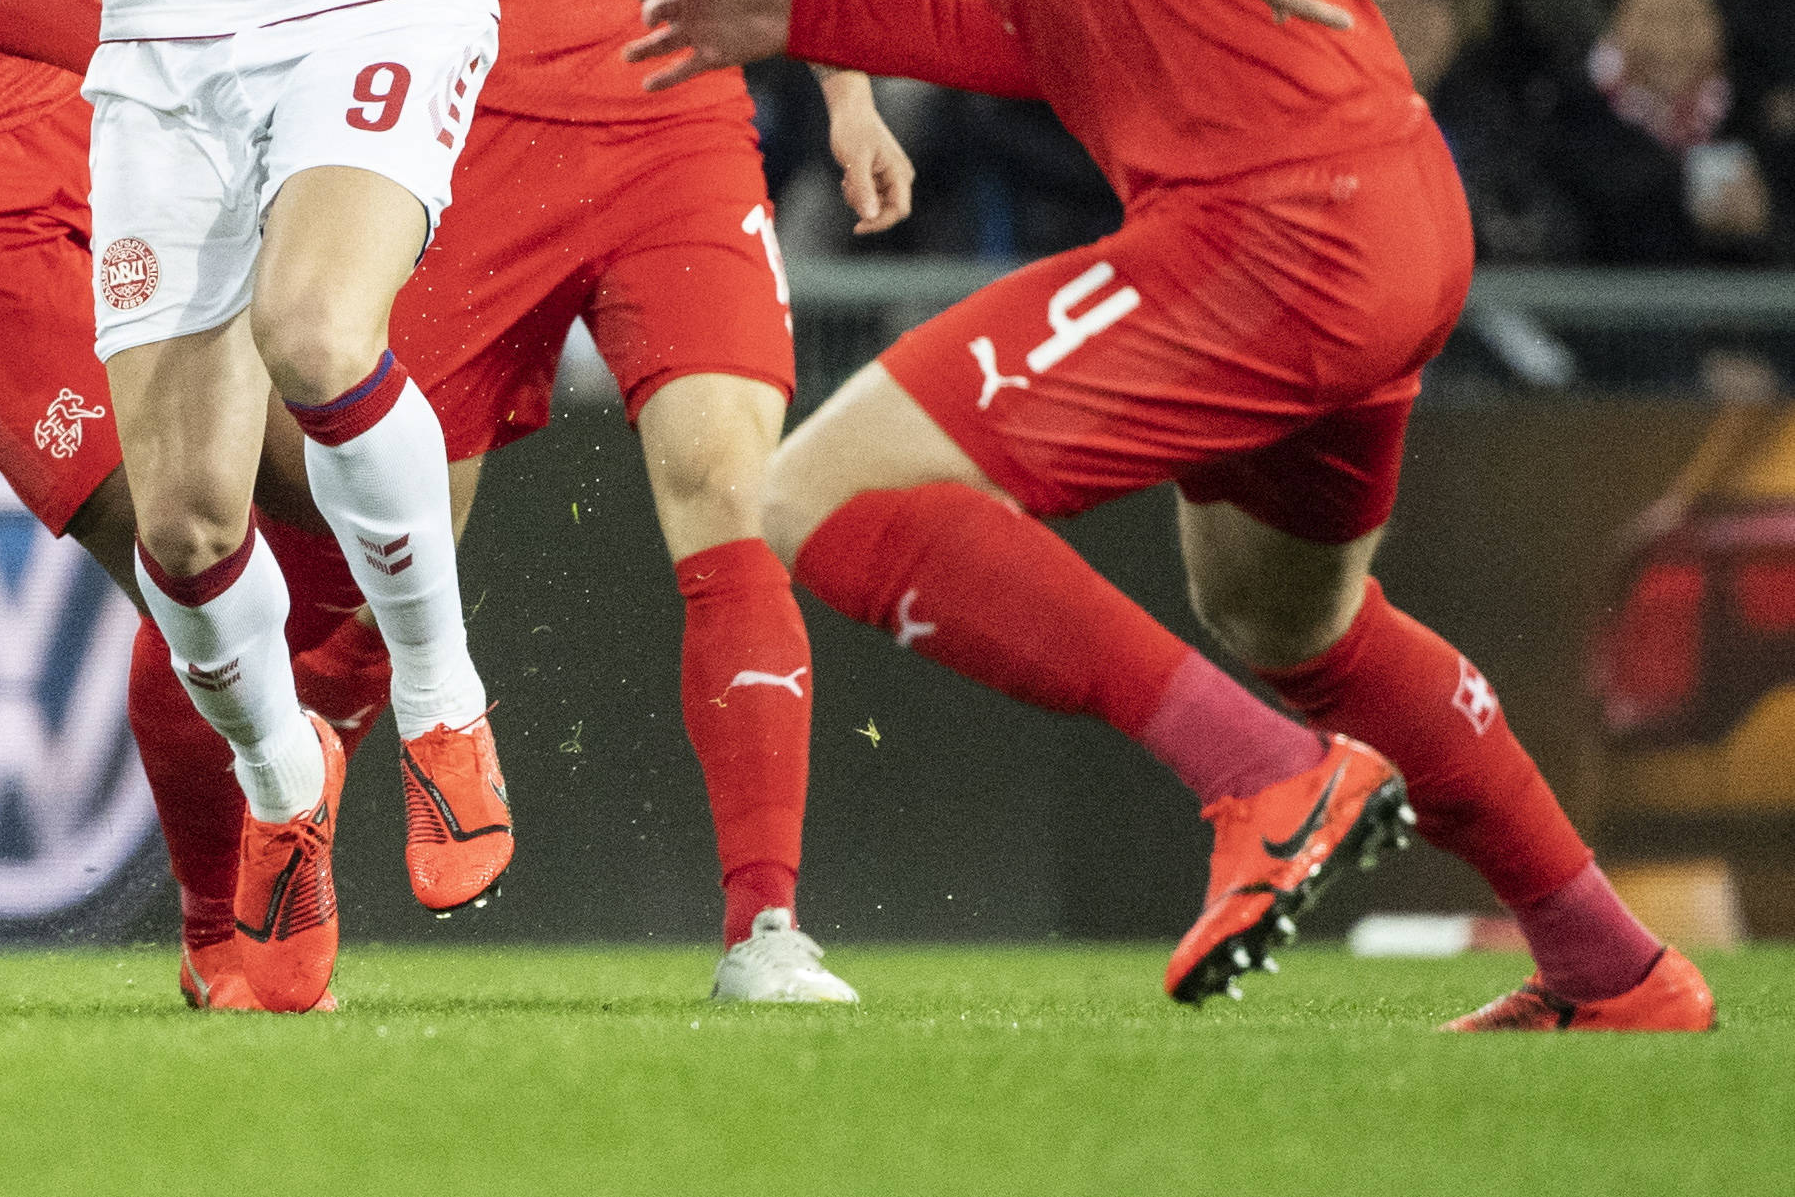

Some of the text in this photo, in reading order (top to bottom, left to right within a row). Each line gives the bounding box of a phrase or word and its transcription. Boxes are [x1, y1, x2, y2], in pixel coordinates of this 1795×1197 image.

[345, 61, 412, 132] 9
[108, 260, 146, 286] DBU
[1026, 261, 1141, 373] 4
